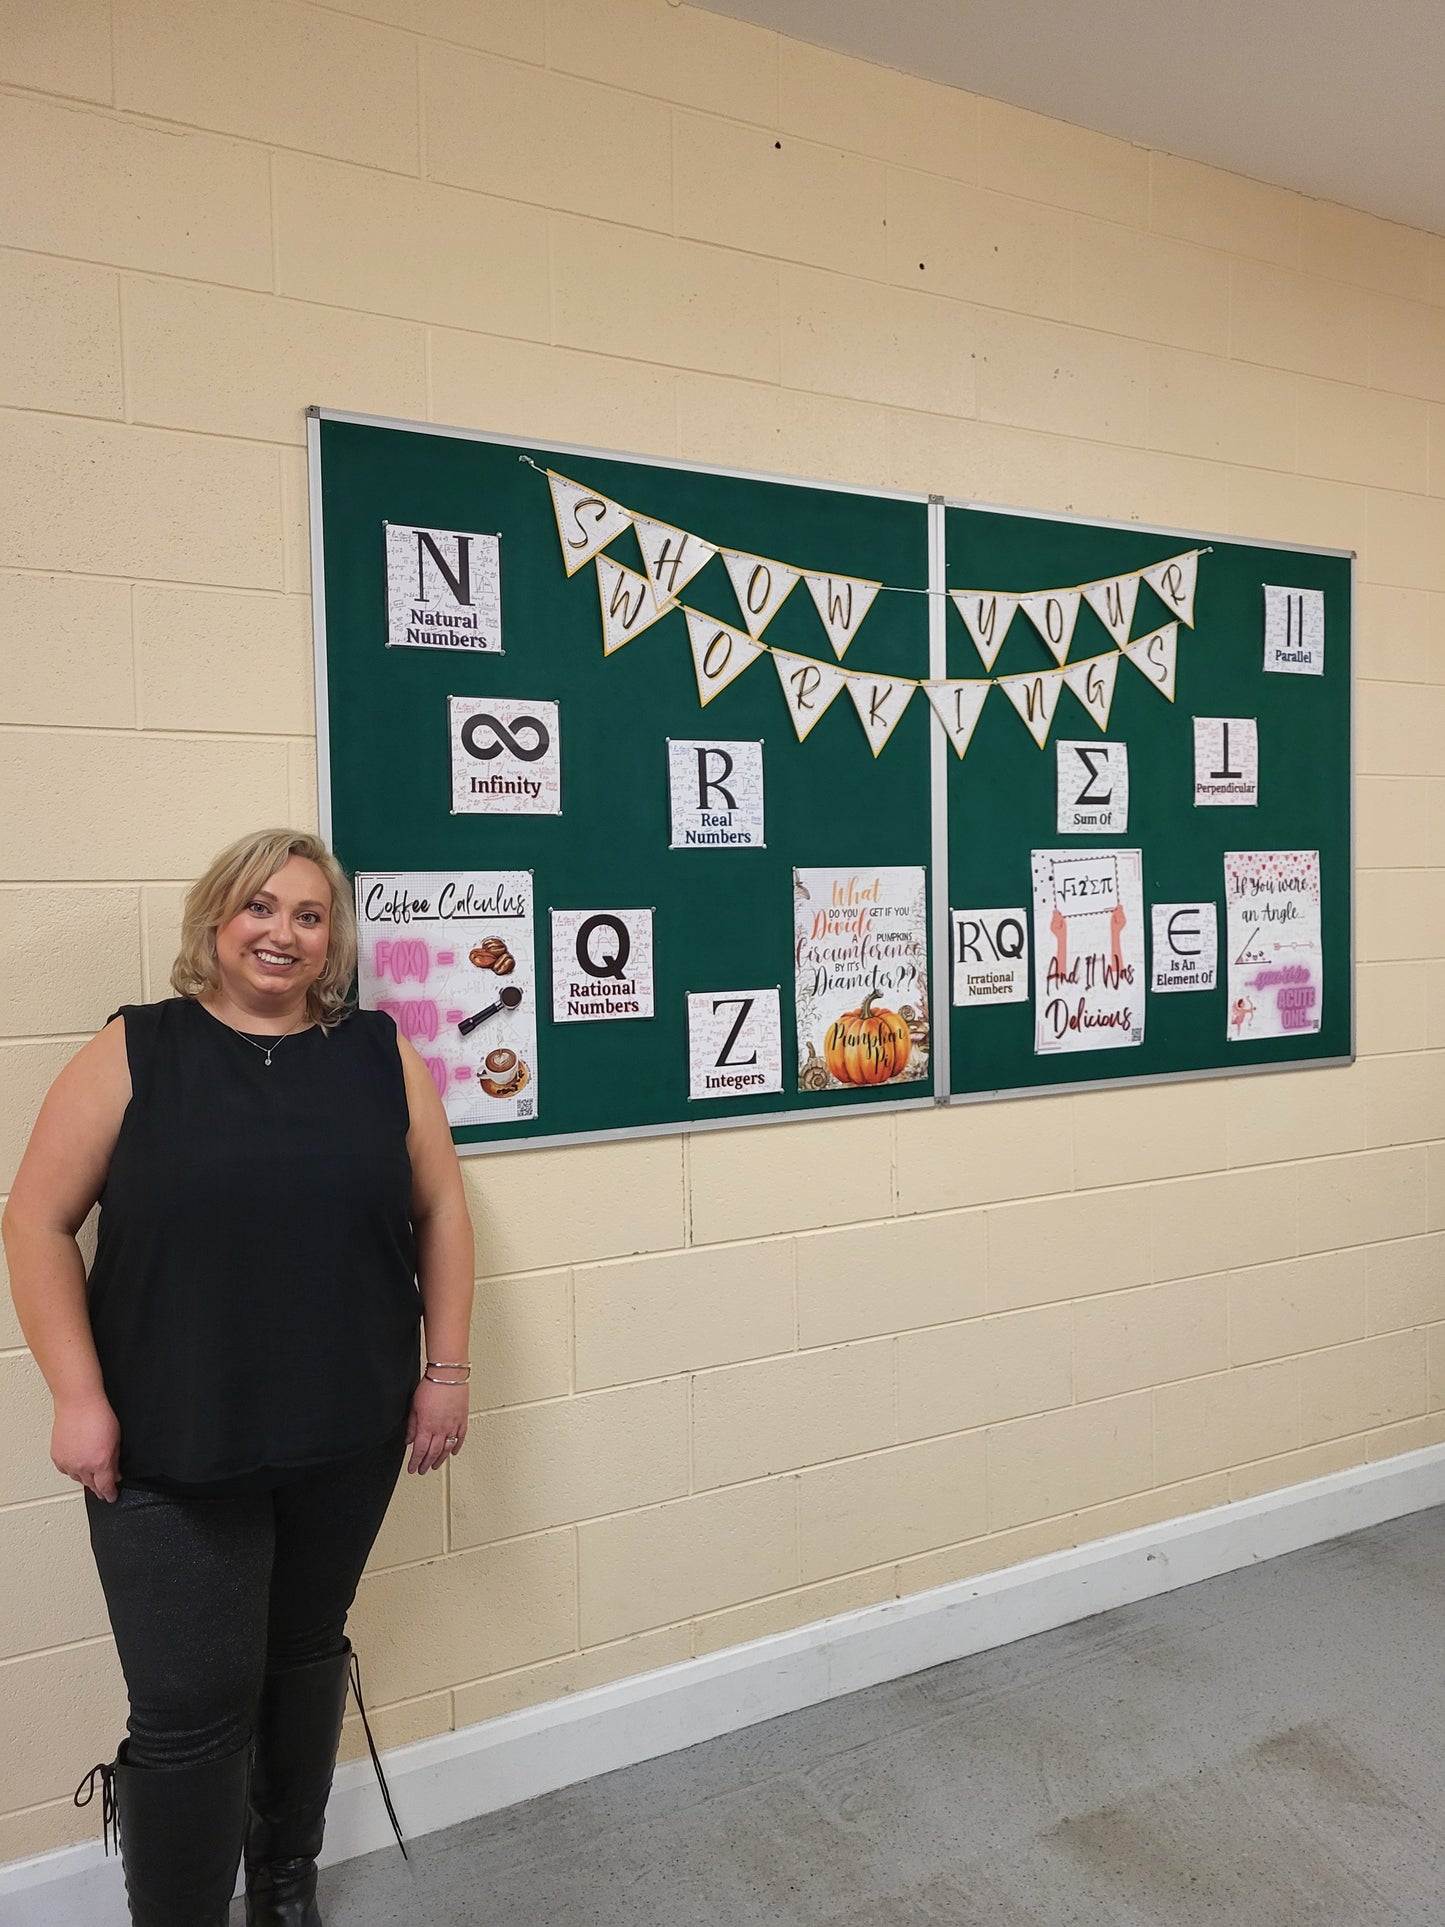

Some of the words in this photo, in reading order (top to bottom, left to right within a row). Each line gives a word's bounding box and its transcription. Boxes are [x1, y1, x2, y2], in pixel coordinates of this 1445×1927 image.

[412, 530, 476, 606] N
[567, 497, 852, 630] SHOW
[978, 563, 1186, 646] YOUR
[410, 608, 478, 629] Natural
[406, 627, 487, 649] Numbers
[1275, 650, 1312, 663] Parallel
[470, 774, 542, 798] Infinity
[693, 747, 739, 810] R
[1196, 783, 1256, 795] Perpendicular
[701, 811, 733, 827] Real
[1073, 813, 1097, 825] Sum
[1099, 812, 1112, 825] Of
[685, 828, 752, 844] Numbers
[832, 875, 882, 907] What
[1278, 877, 1307, 893] were
[364, 882, 431, 925] Coffee
[438, 882, 526, 921] Calculus
[829, 909, 840, 919] DO
[841, 908, 858, 919] YOU
[869, 907, 884, 917] GET
[885, 907, 893, 917] IF
[894, 906, 910, 917] YOU
[811, 907, 873, 940] Divide
[1241, 909, 1259, 924] an
[576, 914, 631, 980] Q
[852, 933, 858, 944] A
[876, 932, 913, 943] PUMPKINS
[835, 963, 846, 973] BY
[1046, 956, 1080, 997] And
[1101, 953, 1135, 991] Was
[1171, 960, 1180, 971] Is
[1181, 960, 1195, 972] An
[967, 972, 1014, 985] Irrational
[1157, 974, 1198, 986] Element
[1200, 971, 1213, 984] Of
[570, 980, 636, 998] Rational
[968, 984, 1014, 997] Numbers
[567, 999, 640, 1016] Numbers
[1278, 987, 1315, 1010] ACUTE
[1045, 996, 1132, 1040] Delicious
[712, 998, 757, 1068] Z
[832, 1022, 903, 1060] Pumpkin
[874, 1047, 888, 1075] Pi
[705, 1072, 766, 1090] Integers
